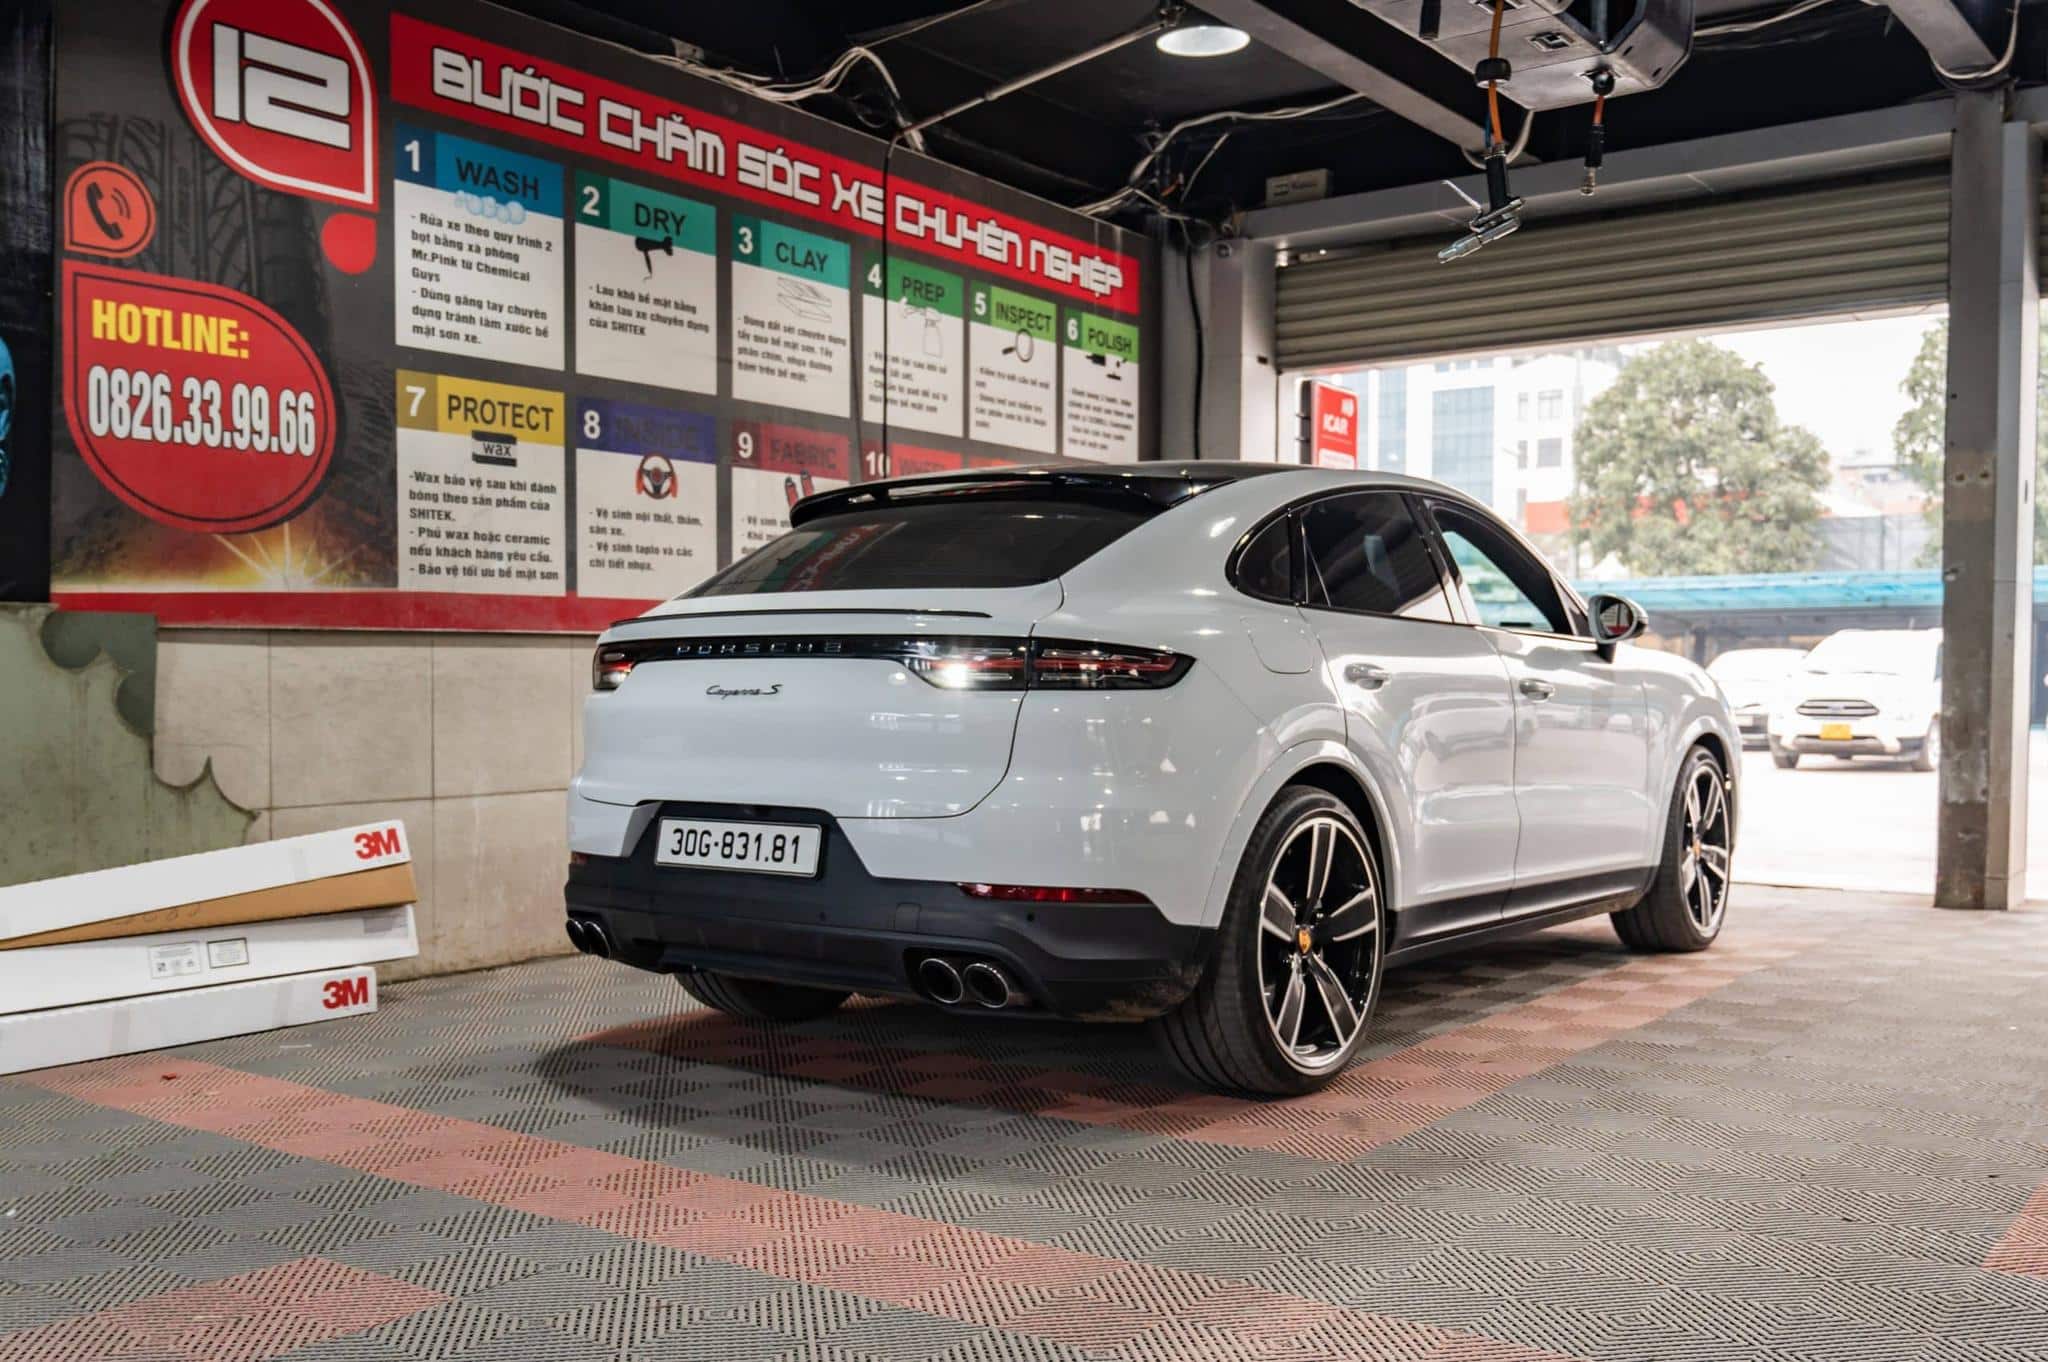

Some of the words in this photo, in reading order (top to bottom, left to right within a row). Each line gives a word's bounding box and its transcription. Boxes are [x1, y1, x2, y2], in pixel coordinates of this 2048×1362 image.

[432, 46, 585, 137] BƯỚC
[599, 98, 726, 177] CHĂM
[737, 141, 820, 205] SÓC
[831, 172, 884, 225] XE
[404, 139, 420, 173] 1
[455, 157, 540, 201] WASH
[582, 185, 601, 217] 2
[634, 202, 687, 236] DRY
[738, 226, 754, 255] 3
[776, 242, 829, 273] CLAY
[411, 267, 440, 283] Guys
[867, 263, 882, 289] 4
[902, 275, 945, 303] PREP
[974, 292, 986, 315] 5
[995, 302, 1052, 332] INSPECT
[91, 298, 249, 360] HOTLINE:
[1067, 318, 1078, 340] 6
[1088, 328, 1132, 354] POLISH
[87, 364, 316, 457] 0826.33.99.66
[405, 385, 426, 417] 7
[447, 394, 554, 433] PROTECT
[583, 409, 601, 440] 8
[1324, 414, 1349, 434] ICAR
[483, 442, 512, 457] wax
[737, 431, 753, 458] 9
[769, 439, 837, 470] FABRIC
[866, 450, 891, 476] 10
[676, 642, 842, 655] PORSCHE
[762, 684, 782, 695] S
[354, 827, 401, 860] 3M
[671, 828, 800, 864] 30G-831.81
[321, 976, 369, 1009] 3M
